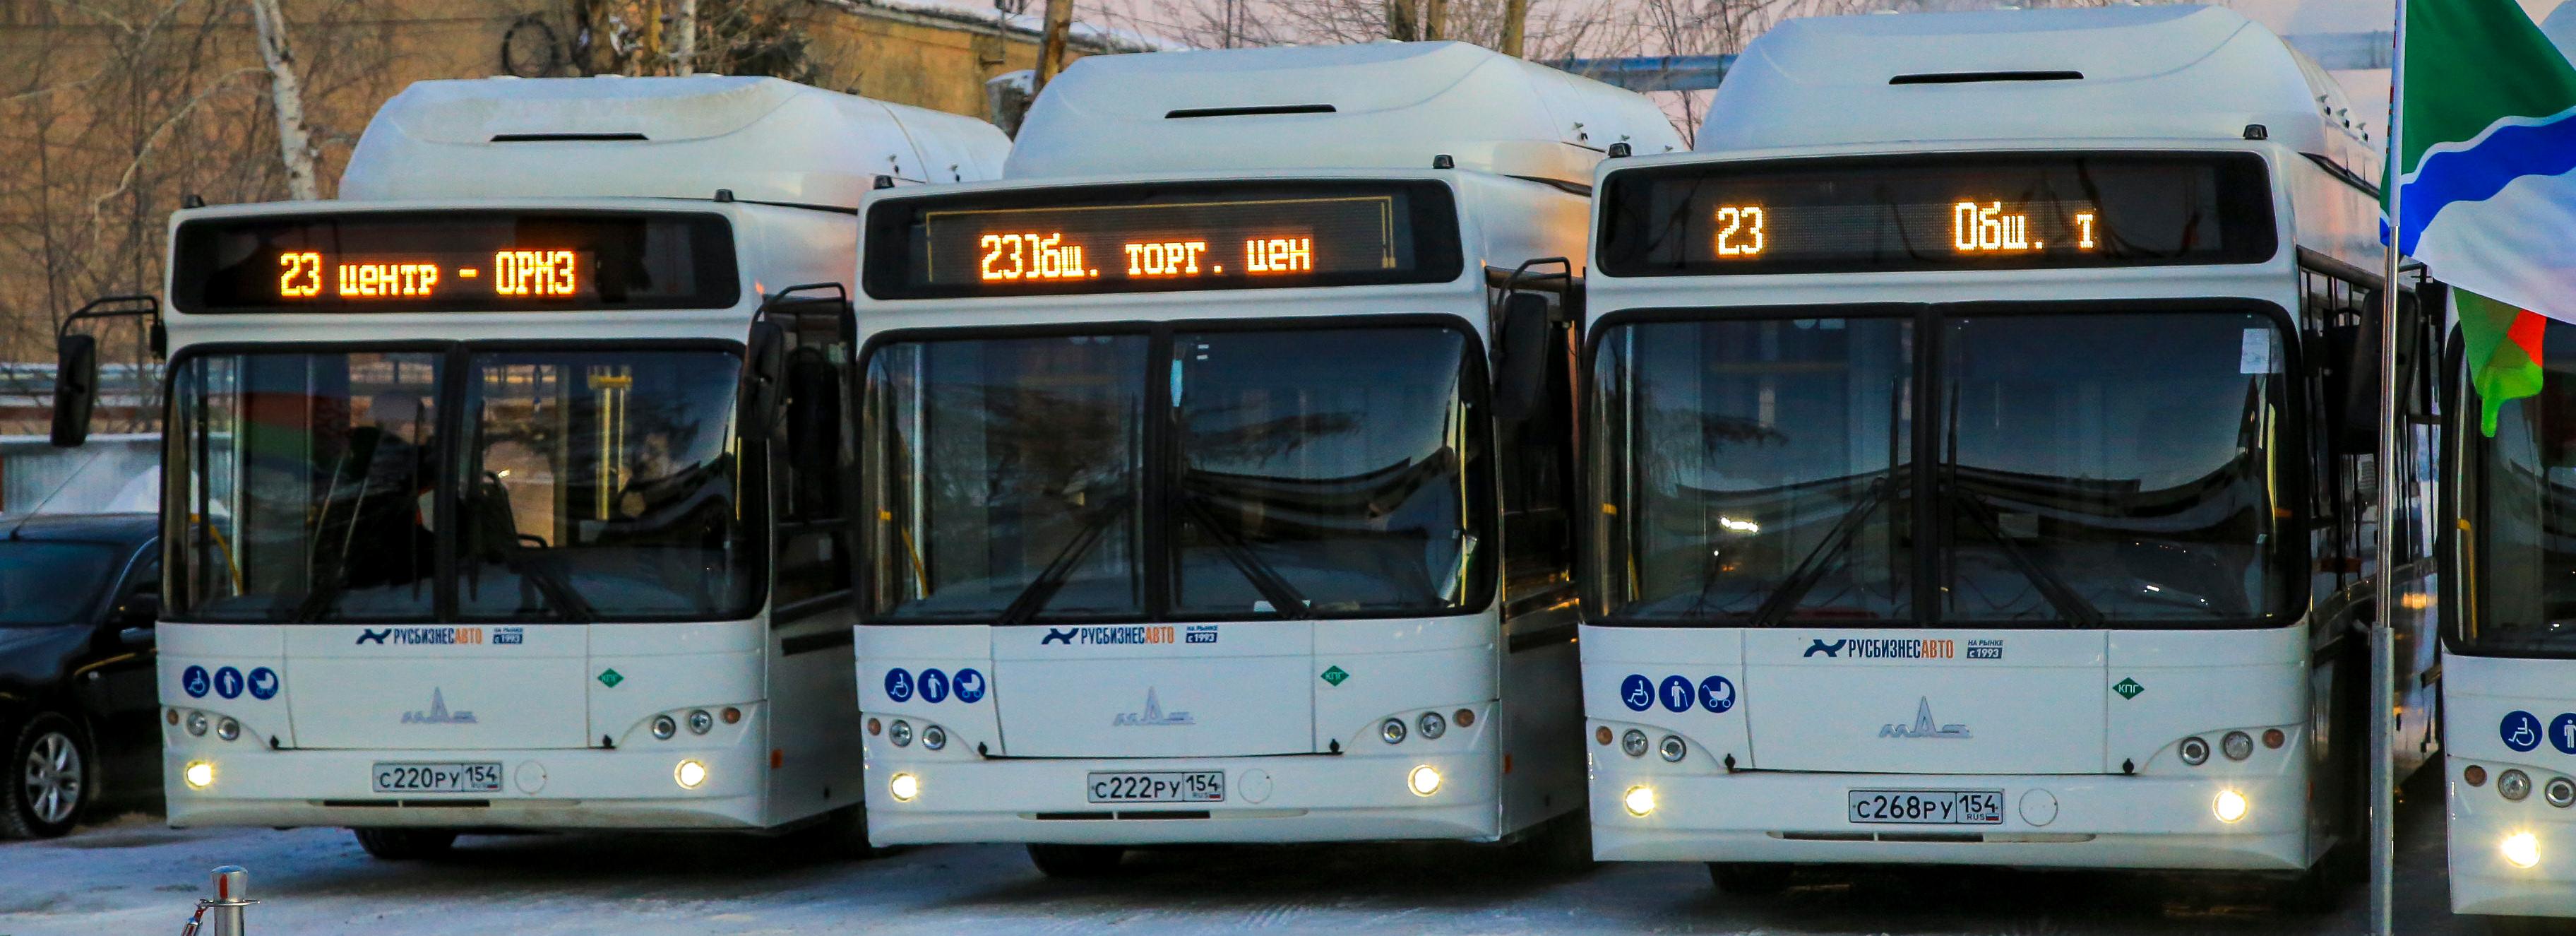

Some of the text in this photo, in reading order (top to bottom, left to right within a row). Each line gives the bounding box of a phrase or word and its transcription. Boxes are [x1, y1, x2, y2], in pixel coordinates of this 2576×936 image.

[1717, 206, 1764, 256] 23
[1954, 201, 2044, 251] Общ.
[1124, 241, 1222, 276] торг.
[1246, 237, 1311, 273] цен
[280, 251, 321, 297] 23
[338, 263, 439, 297] центр
[495, 250, 576, 295] ОРМЗ
[1848, 639, 1955, 658] РУСБИЗНЕСАВТО
[1976, 648, 2000, 658] 1993
[2118, 684, 2140, 693] КПГ
[465, 766, 497, 782] 154
[1185, 774, 1219, 792] 154
[1959, 794, 1996, 813] 154
